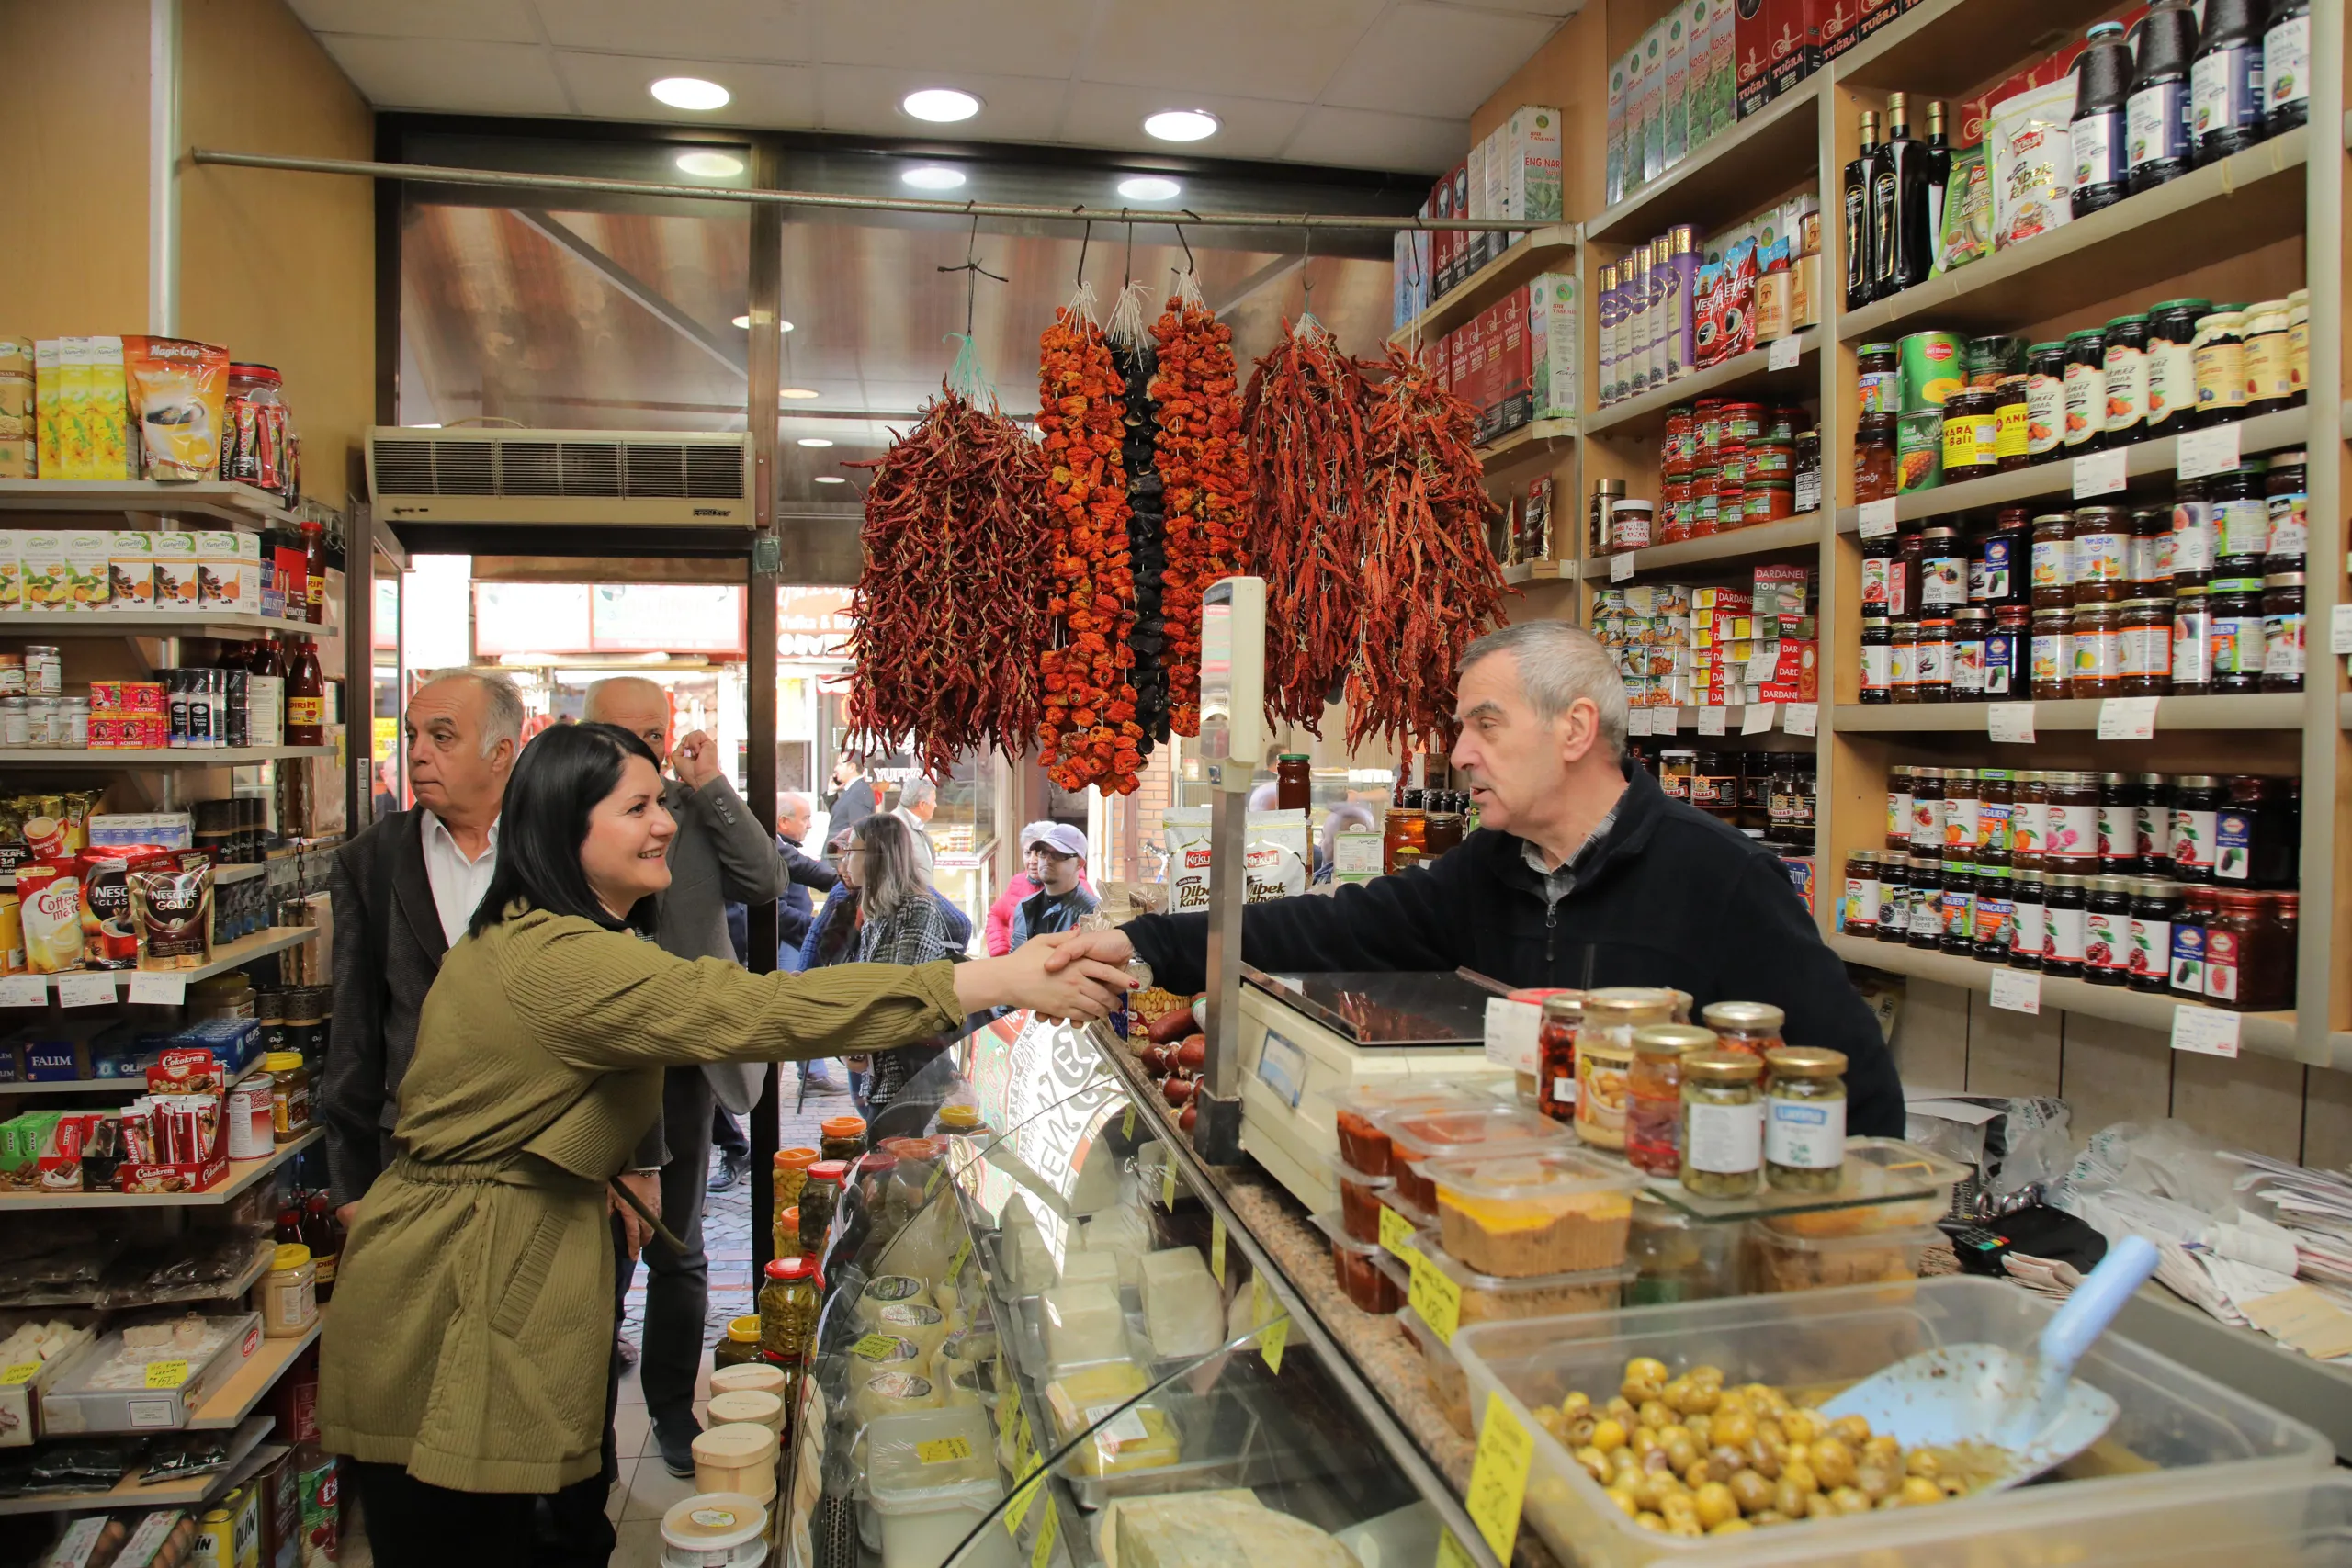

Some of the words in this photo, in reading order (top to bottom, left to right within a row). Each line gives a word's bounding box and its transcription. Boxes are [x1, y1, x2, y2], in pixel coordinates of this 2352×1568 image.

[1525, 156, 1561, 169] ENGİNAR
[151, 344, 179, 358] Magic
[180, 345, 200, 359] Cup
[1756, 570, 1805, 579] DARDANEL
[1756, 582, 1776, 591] TON
[156, 899, 195, 911] GOLD
[31, 1056, 73, 1066] FALIM
[162, 1055, 205, 1068] Çokokrem
[136, 1168, 175, 1179] Çokokrem
